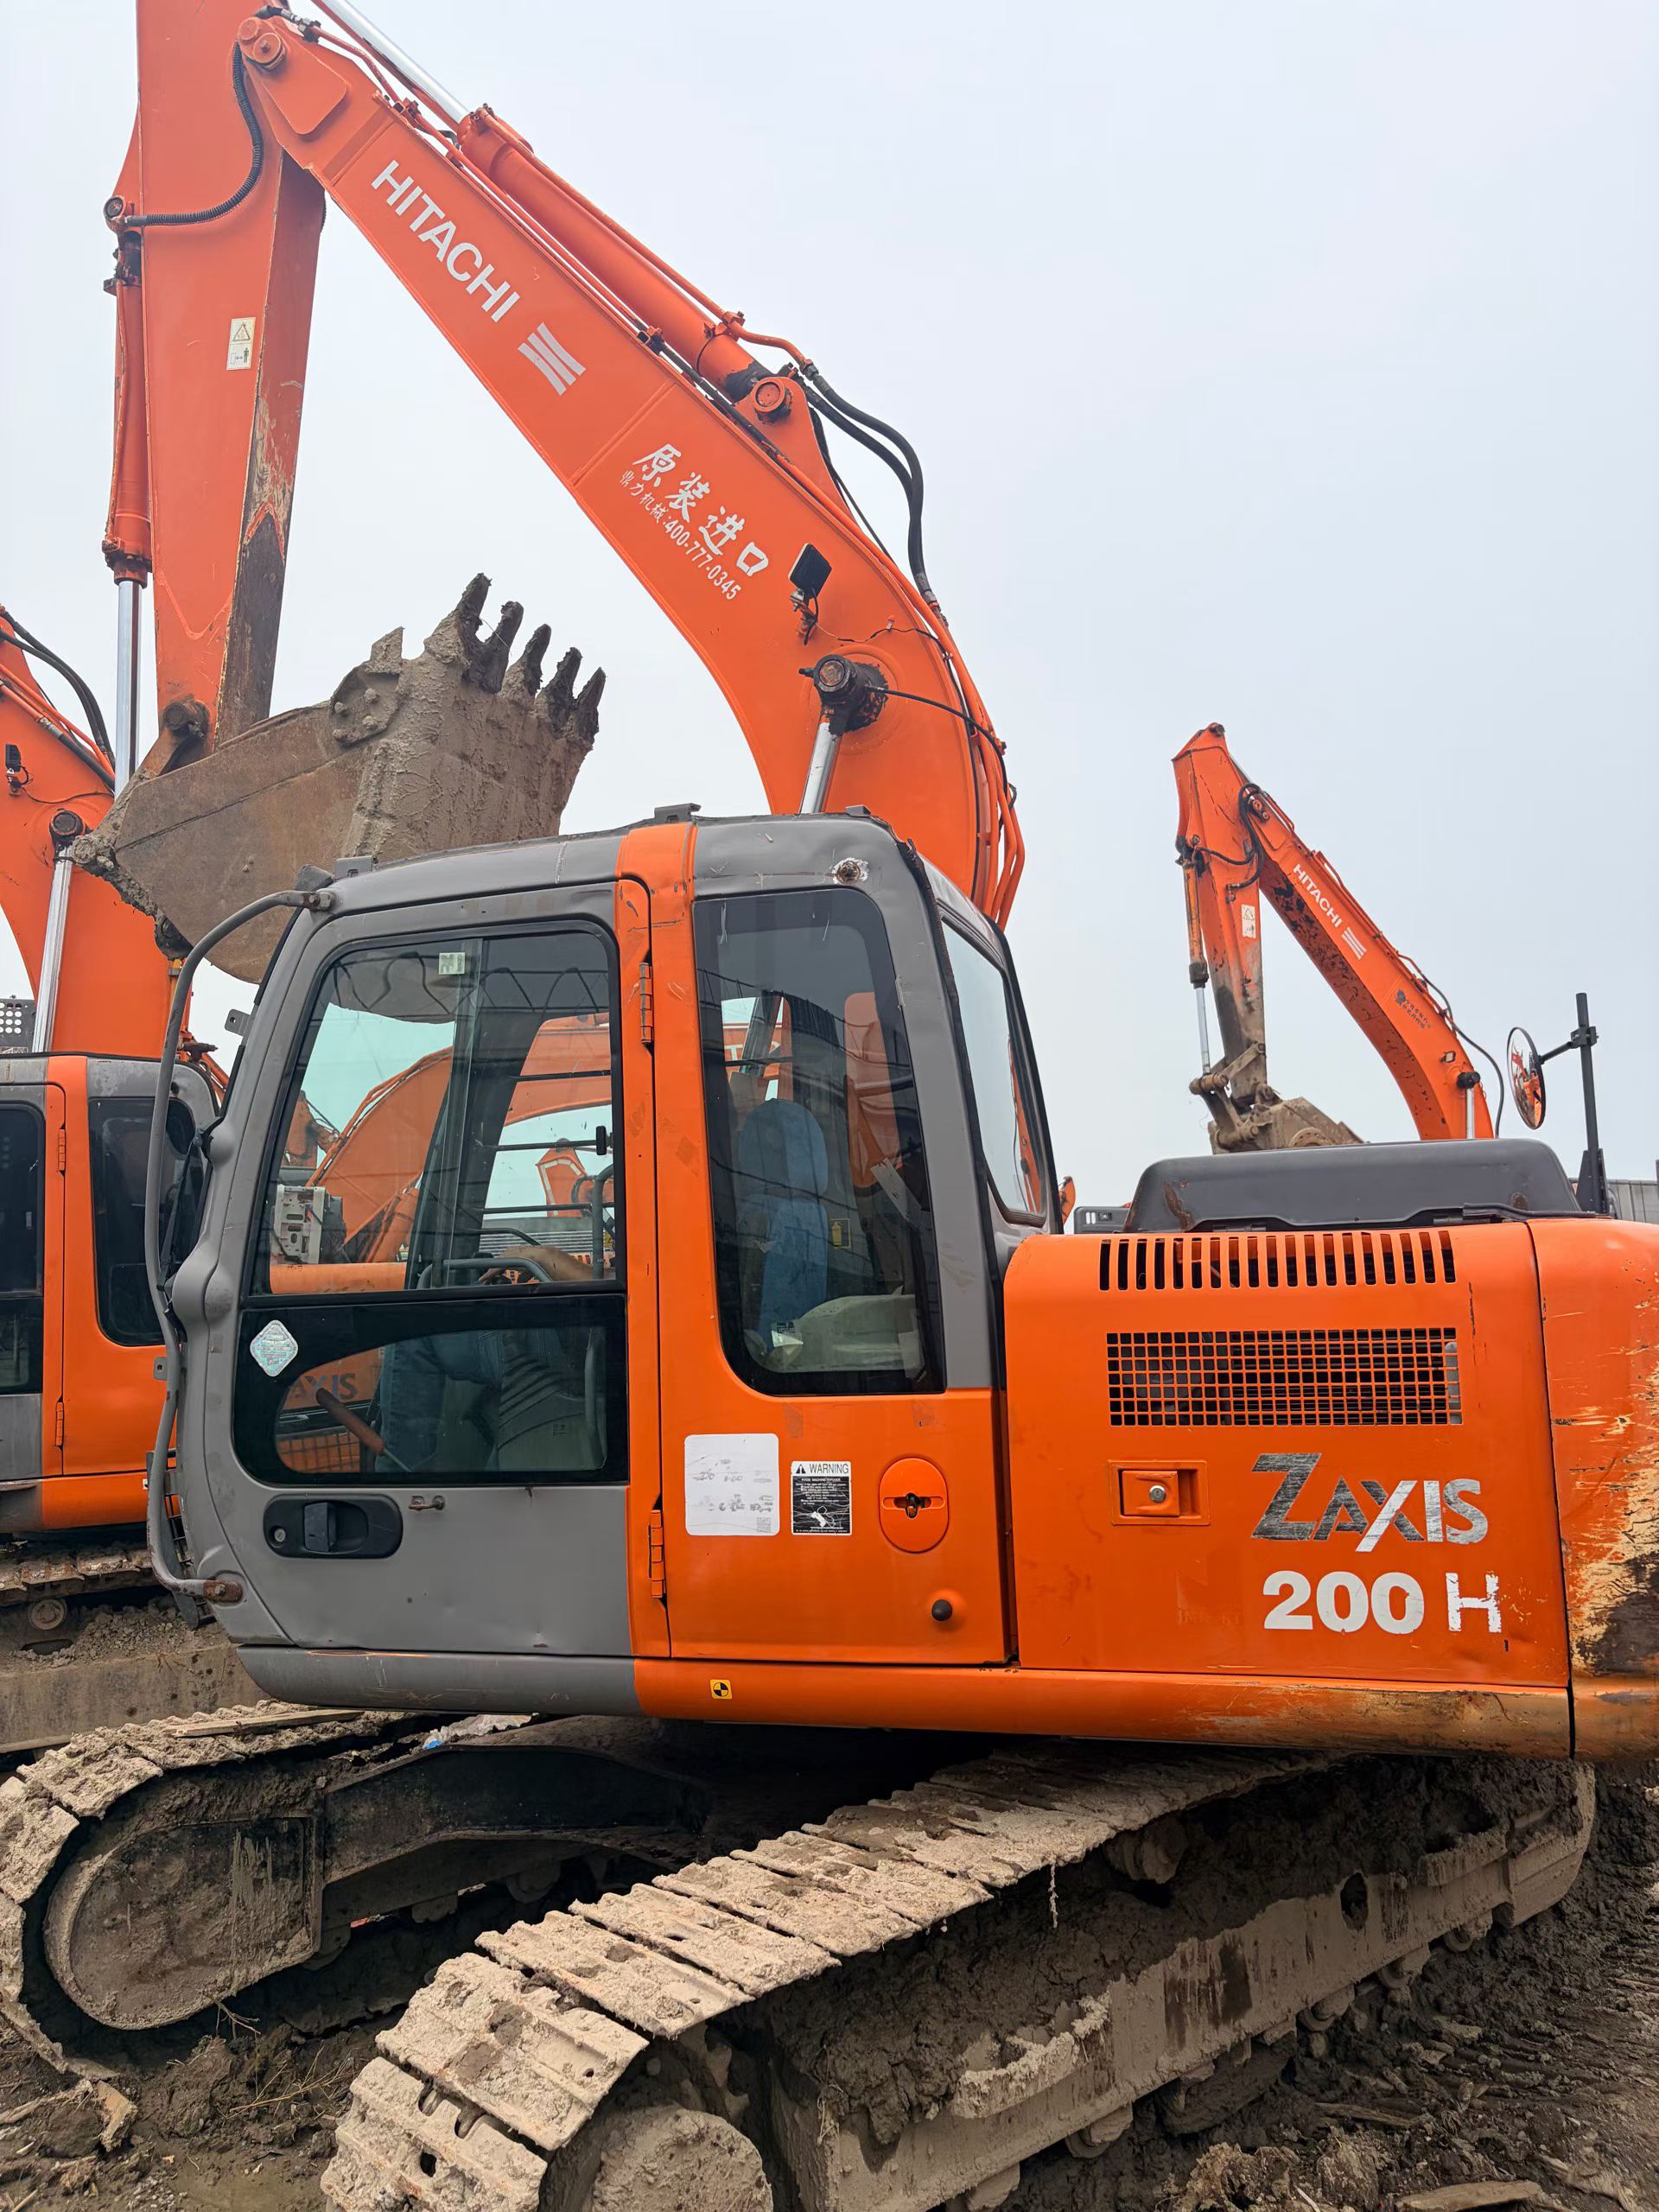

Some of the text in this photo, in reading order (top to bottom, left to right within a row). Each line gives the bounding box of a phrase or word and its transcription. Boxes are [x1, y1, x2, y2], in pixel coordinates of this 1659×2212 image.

[371, 159, 520, 323] HITACHI
[632, 443, 769, 577] 原装进口
[1293, 863, 1343, 928] HITACHI
[809, 1463, 849, 1474] WARNING
[1250, 1452, 1489, 1553] ZAXIS
[1262, 1570, 1503, 1635] 200 H
